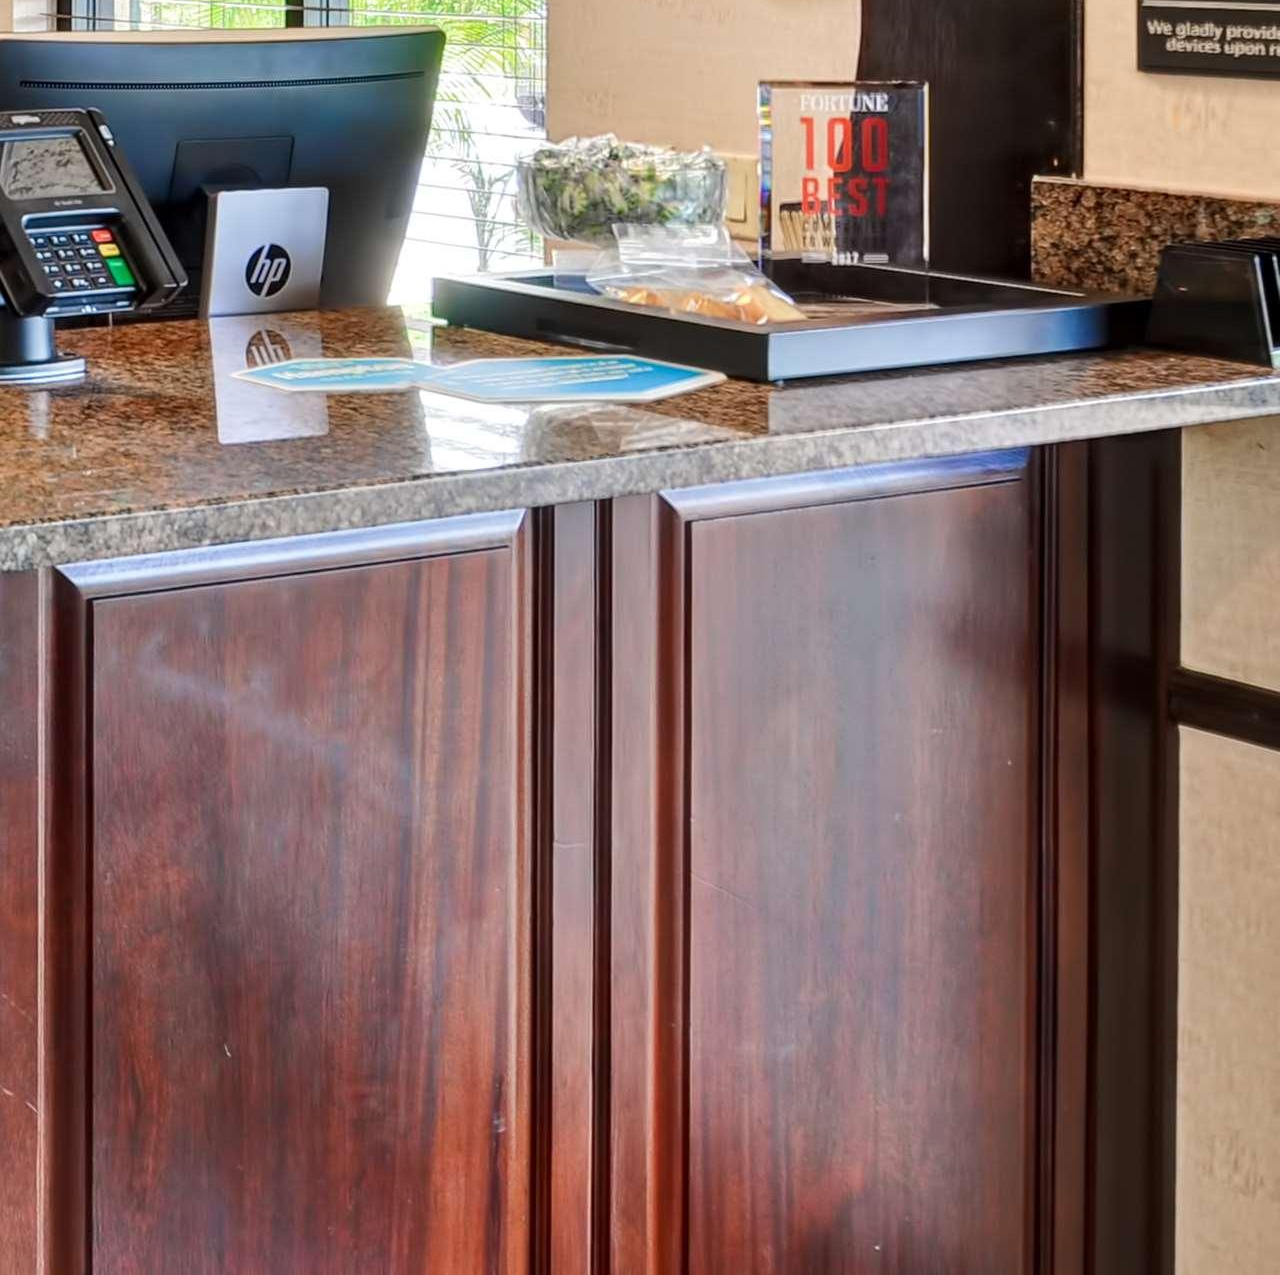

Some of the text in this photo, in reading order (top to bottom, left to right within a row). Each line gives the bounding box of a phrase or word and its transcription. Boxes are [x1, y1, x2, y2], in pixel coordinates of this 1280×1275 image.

[1146, 20, 1173, 35] We
[1175, 22, 1223, 41] gladly
[1165, 37, 1221, 54] devices
[1224, 42, 1266, 57] upon
[800, 93, 889, 112] FORTUNE
[800, 116, 889, 173] 100
[802, 177, 890, 218] BEST
[250, 244, 288, 298] hp
